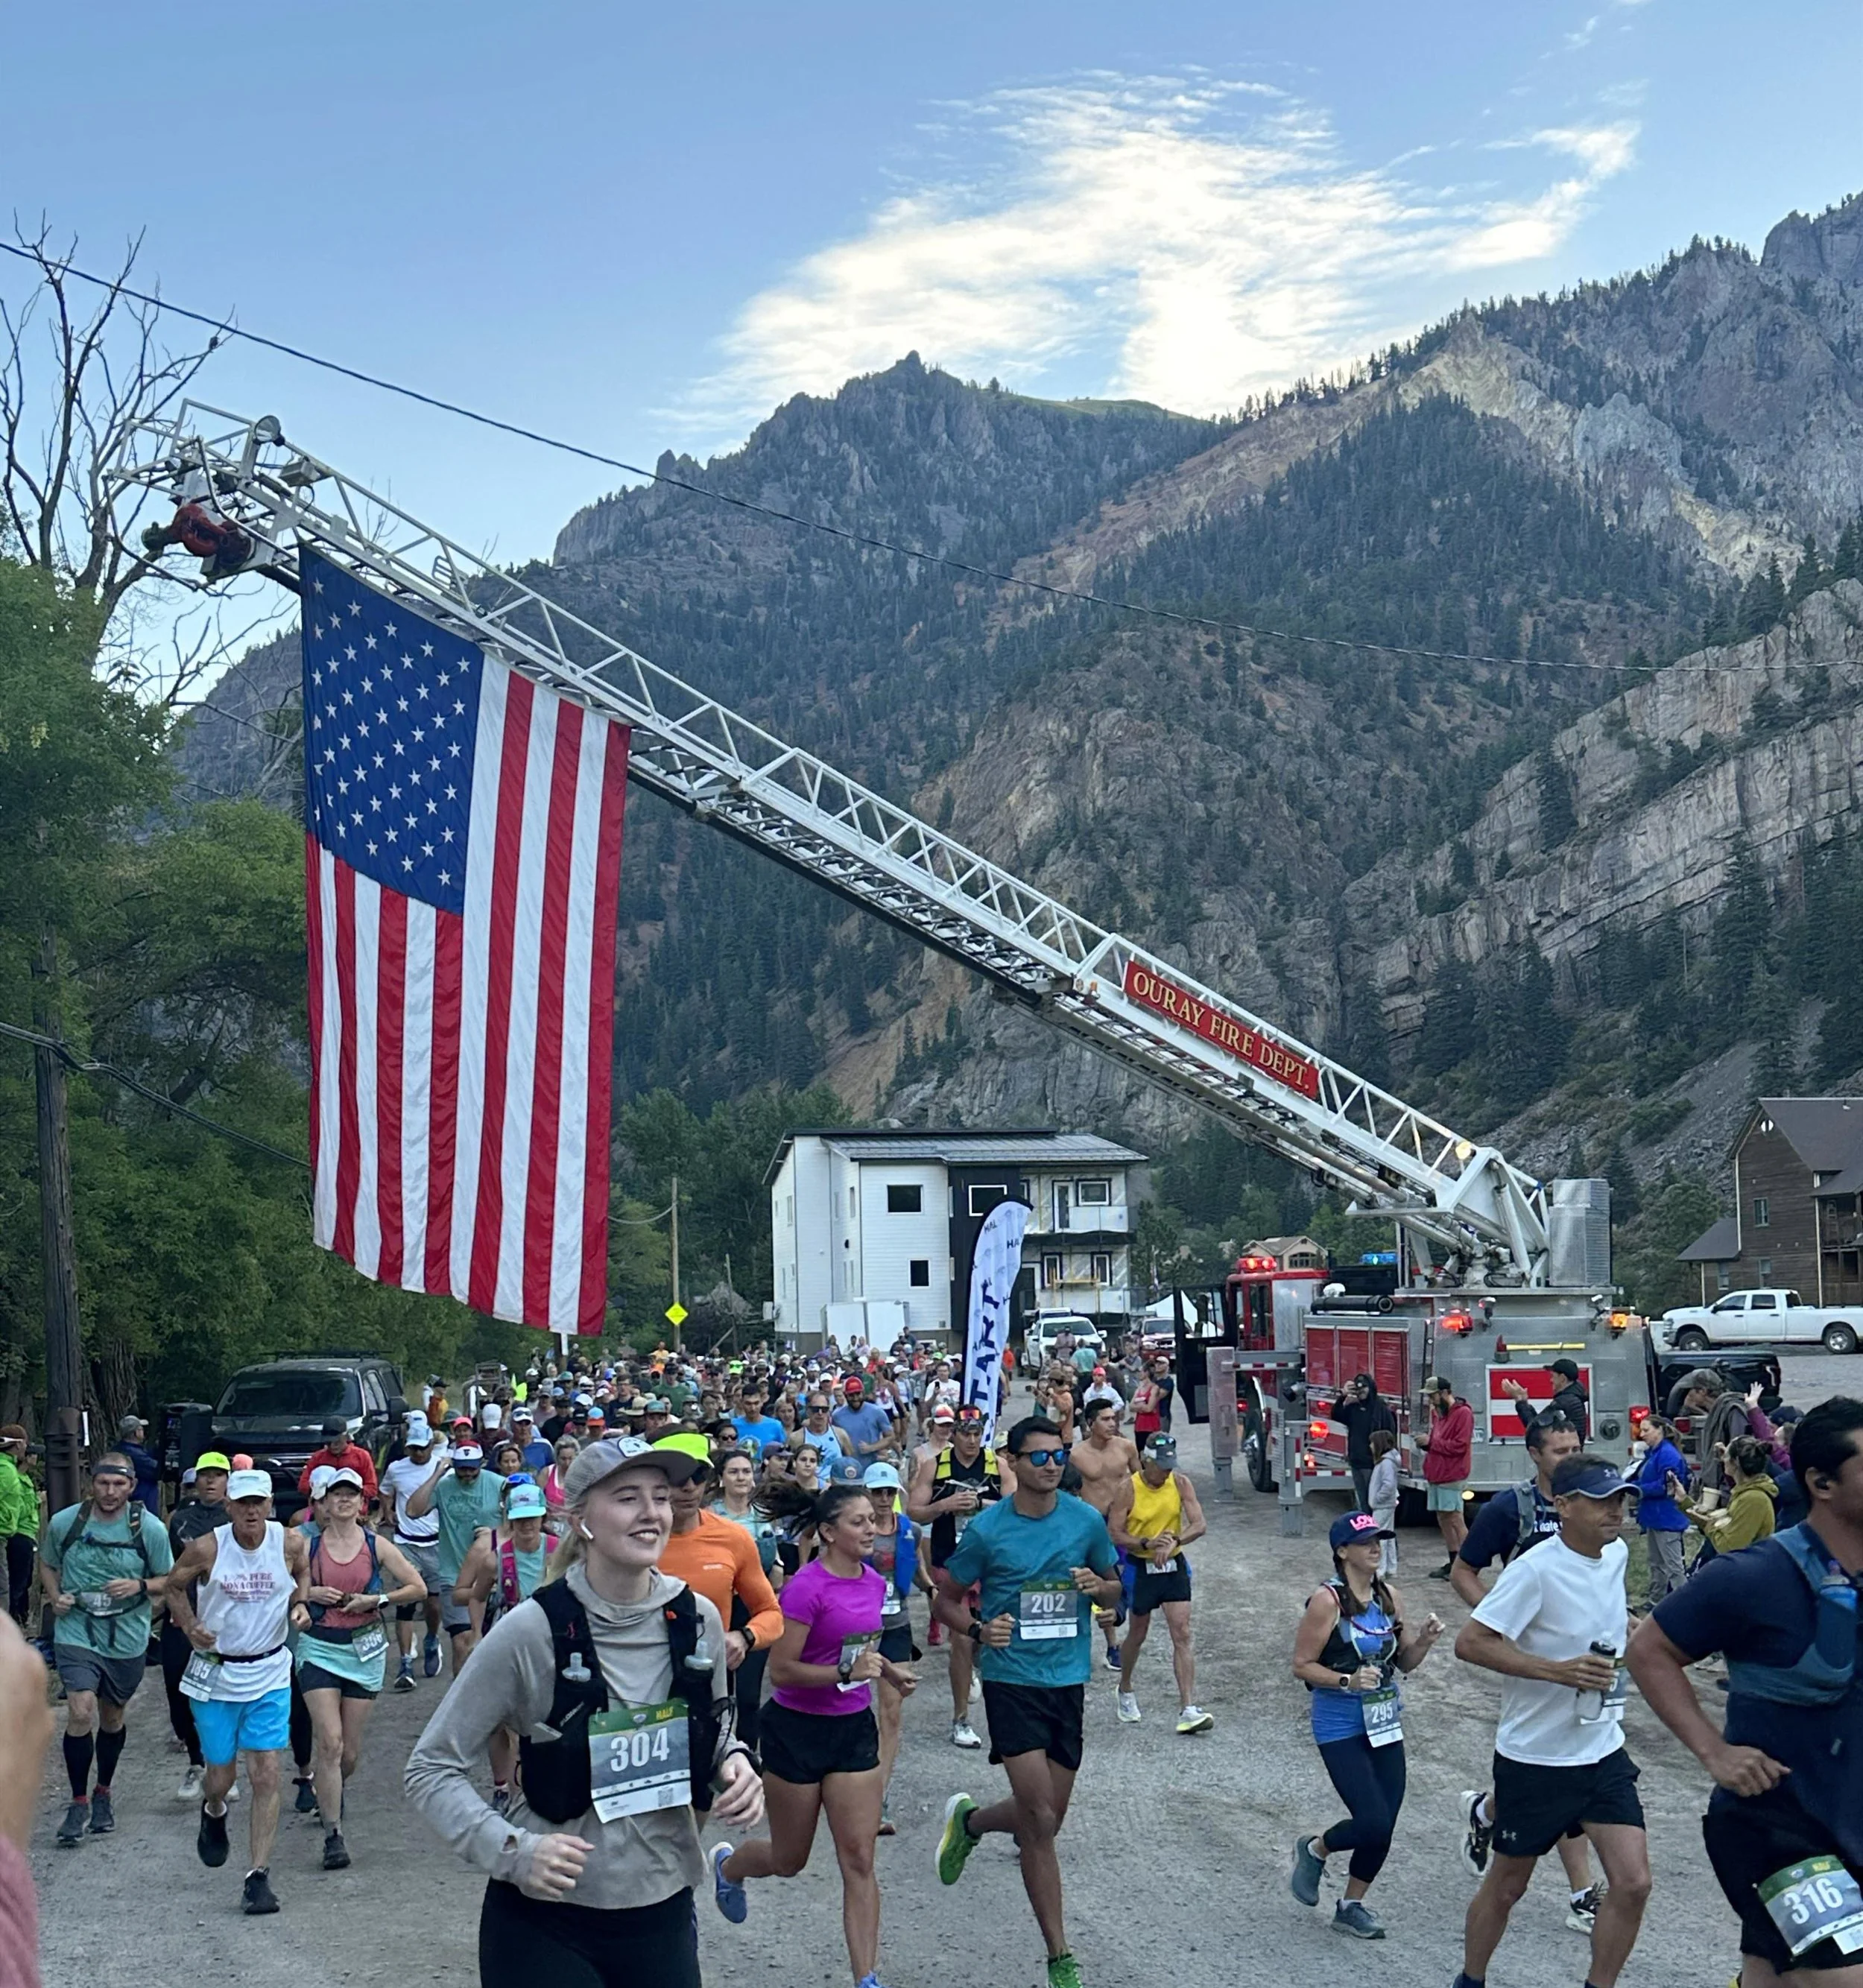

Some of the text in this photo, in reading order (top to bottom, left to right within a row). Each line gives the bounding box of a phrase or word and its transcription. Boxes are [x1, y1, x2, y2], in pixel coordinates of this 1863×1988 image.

[1133, 972, 1309, 1089] OURAY FIRE DEPT.
[970, 1282, 999, 1441] TART
[93, 1594, 112, 1607] 45
[1031, 1593, 1066, 1613] 202
[190, 1659, 213, 1679] 185
[1371, 1702, 1394, 1723] 295
[610, 1727, 670, 1772] 304
[1783, 1878, 1844, 1925] 316
